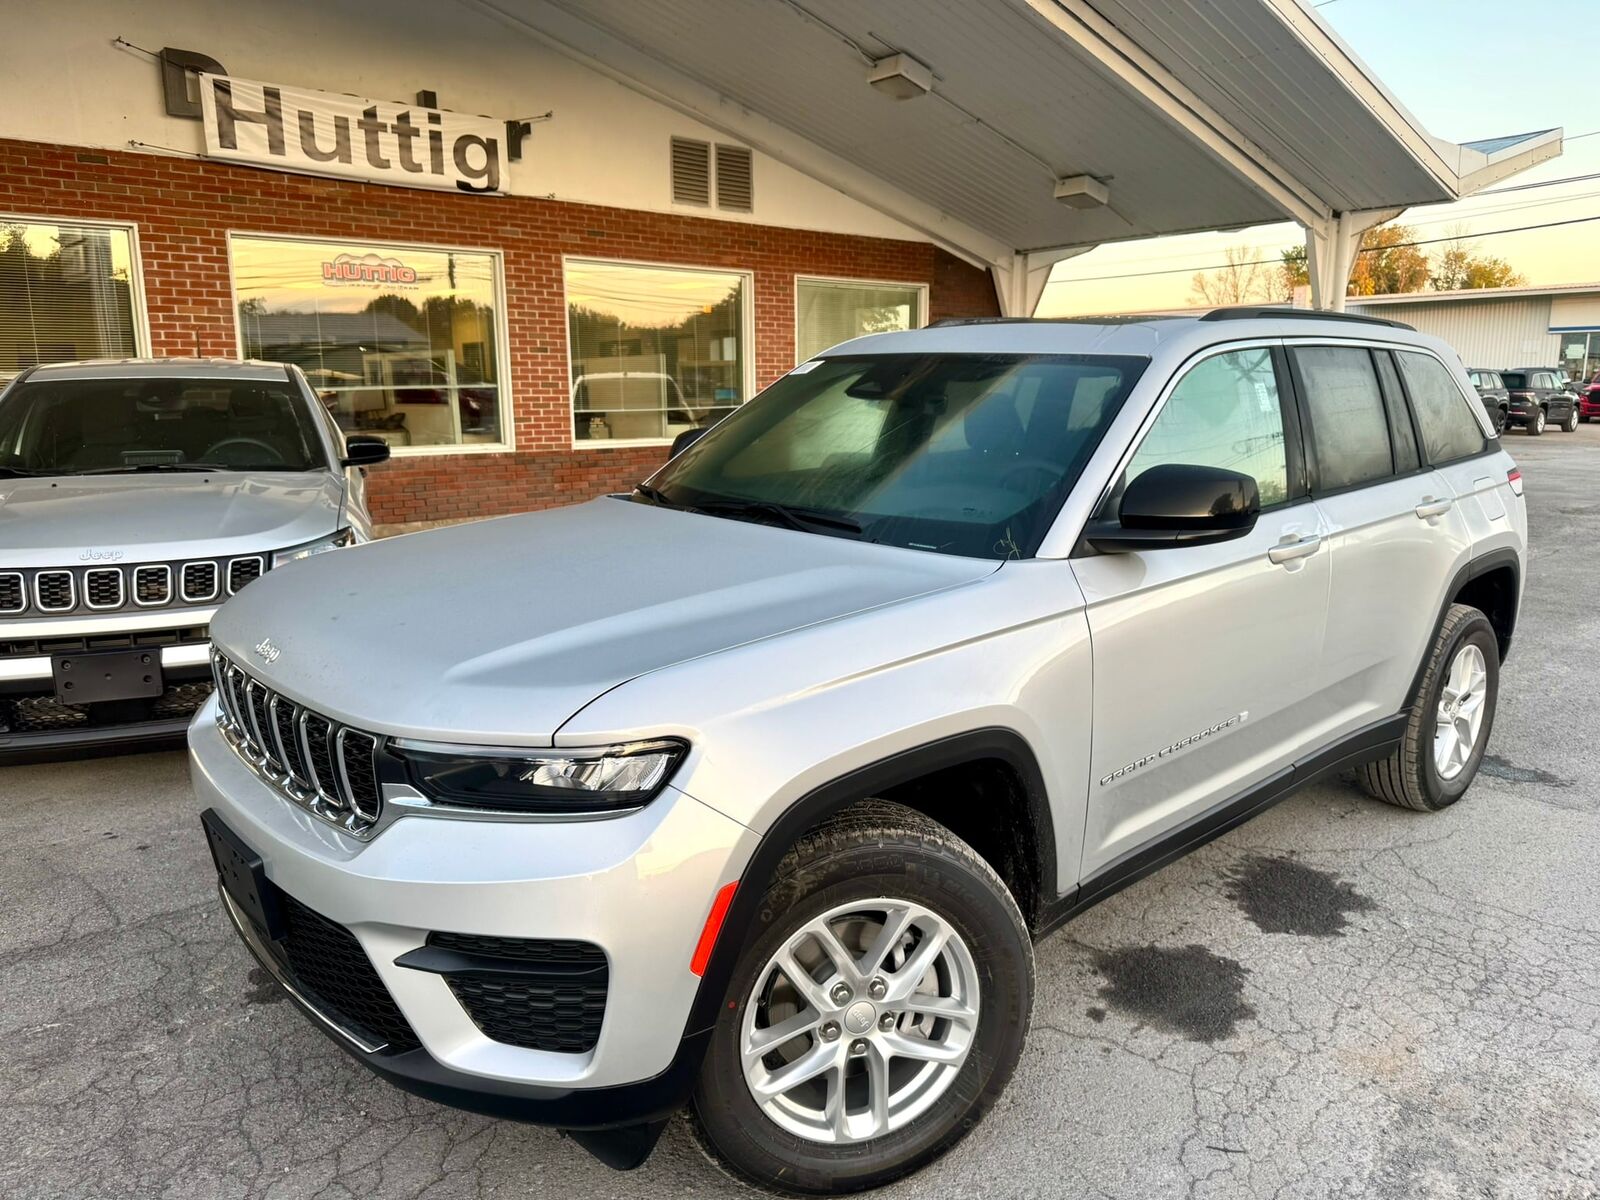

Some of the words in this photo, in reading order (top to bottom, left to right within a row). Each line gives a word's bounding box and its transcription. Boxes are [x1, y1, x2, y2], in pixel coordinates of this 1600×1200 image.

[212, 78, 499, 192] Huttig
[322, 262, 417, 284] HUTTIG
[79, 548, 124, 561] Jeep
[255, 638, 281, 664] Jeep
[1100, 754, 1156, 786] GRAND
[1159, 717, 1238, 758] CHEROKEE
